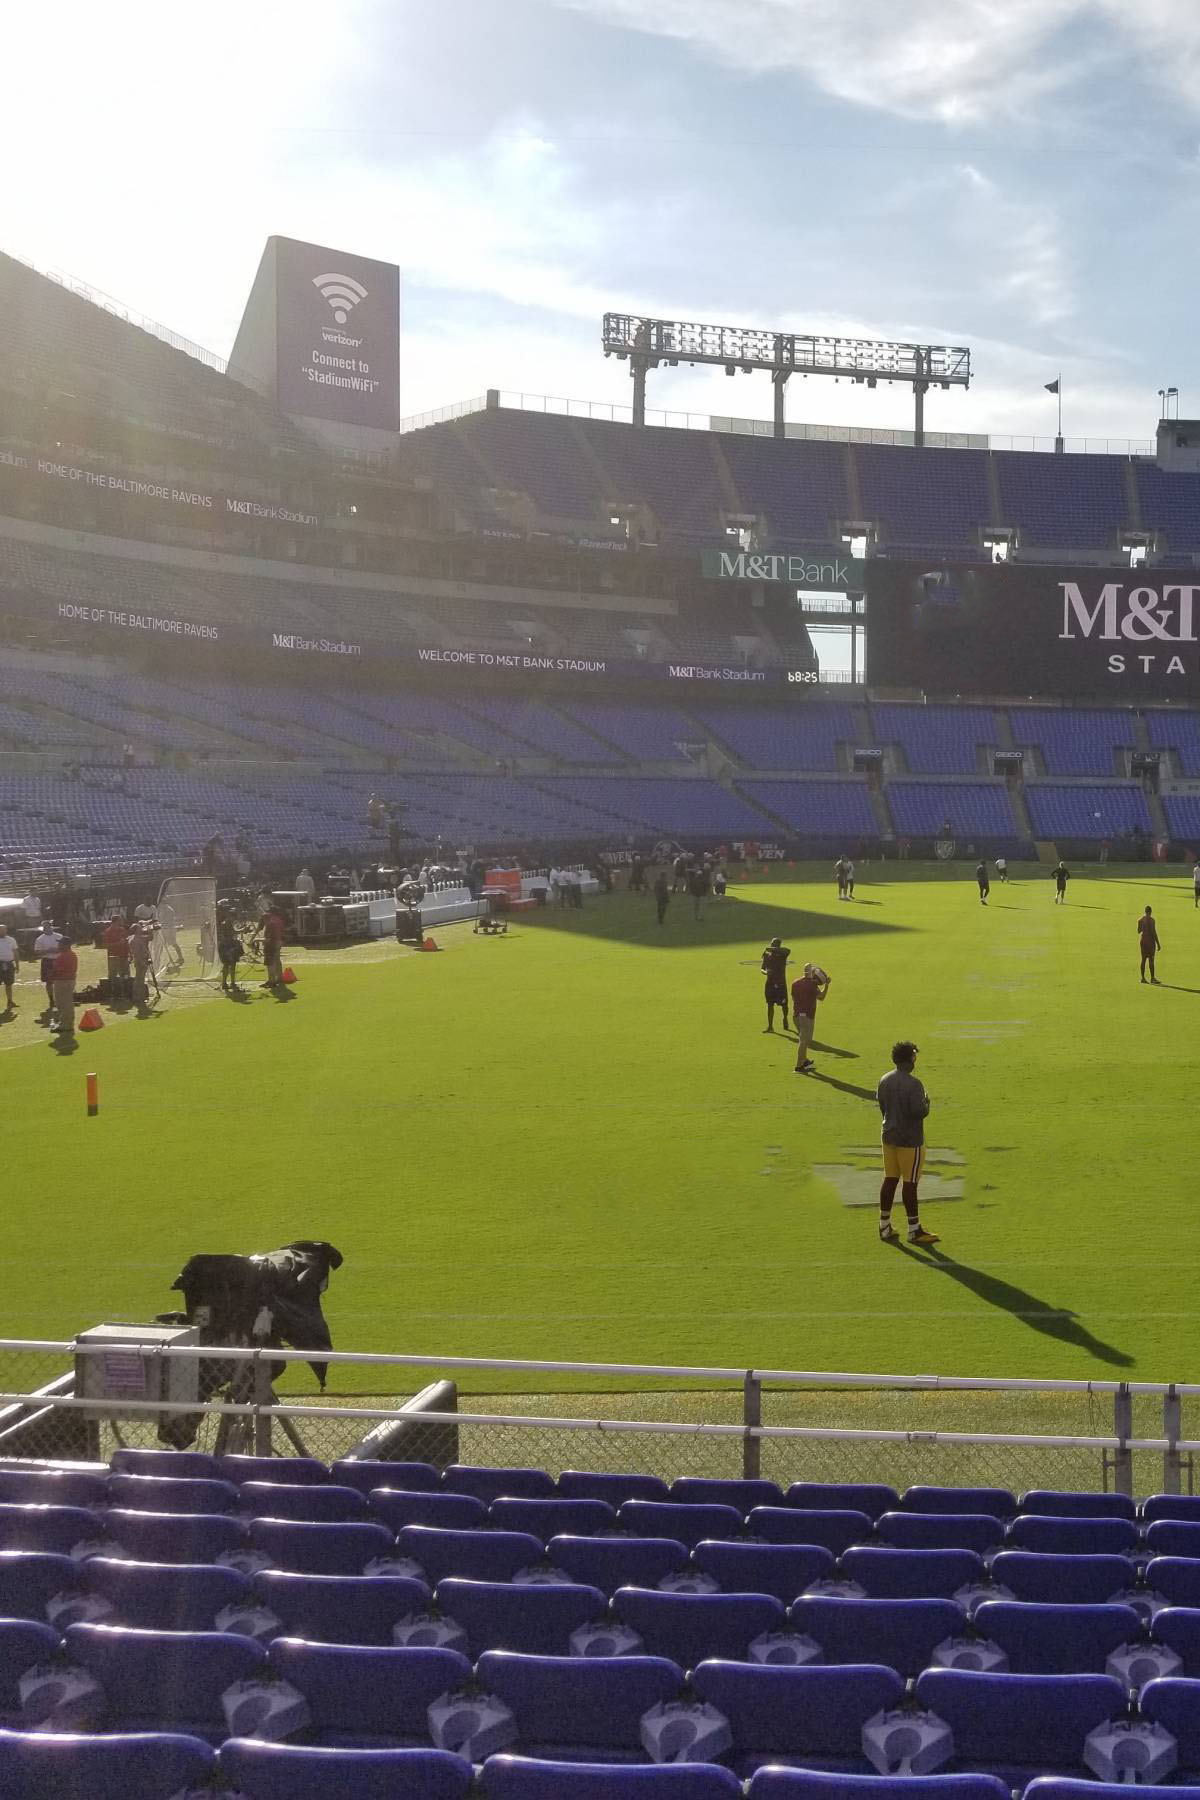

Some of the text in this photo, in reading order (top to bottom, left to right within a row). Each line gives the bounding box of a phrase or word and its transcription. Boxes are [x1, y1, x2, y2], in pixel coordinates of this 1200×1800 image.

[321, 332, 359, 347] verizon
[312, 350, 369, 373] Connect to
[37, 459, 212, 507] HOME OF THE BALTIMORE RAVENS
[226, 499, 318, 525] M&T Bank Stadium
[718, 552, 849, 584] M&T Bank
[58, 603, 218, 639] HOME OF THE BALTIMORE RAVENS
[272, 633, 360, 655] M&T Bank Stadium
[418, 649, 606, 672] WELCOME TO M&T BANK STADIUM
[668, 665, 765, 681] M&T Bank Stadium
